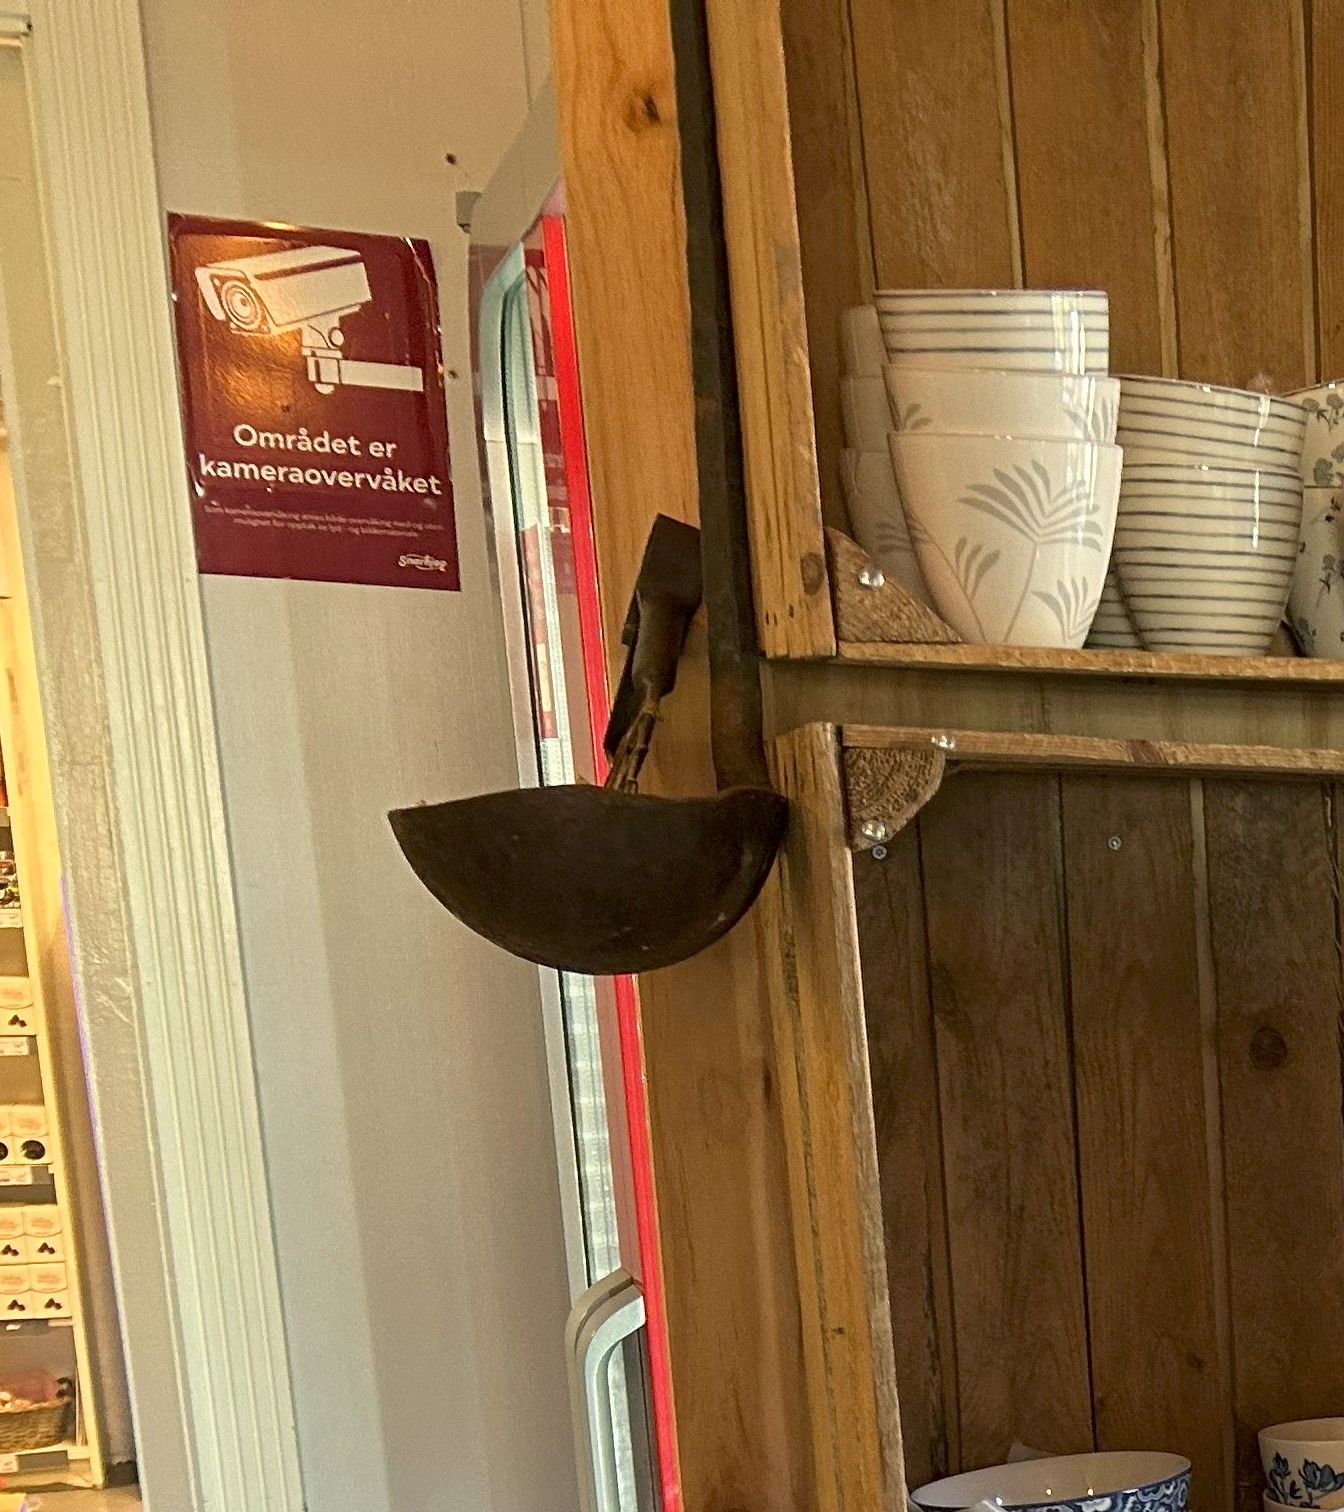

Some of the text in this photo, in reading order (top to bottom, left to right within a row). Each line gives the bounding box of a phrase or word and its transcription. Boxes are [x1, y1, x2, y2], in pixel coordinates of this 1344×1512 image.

[233, 423, 398, 459] Området er
[199, 454, 442, 496] kameraovervåket
